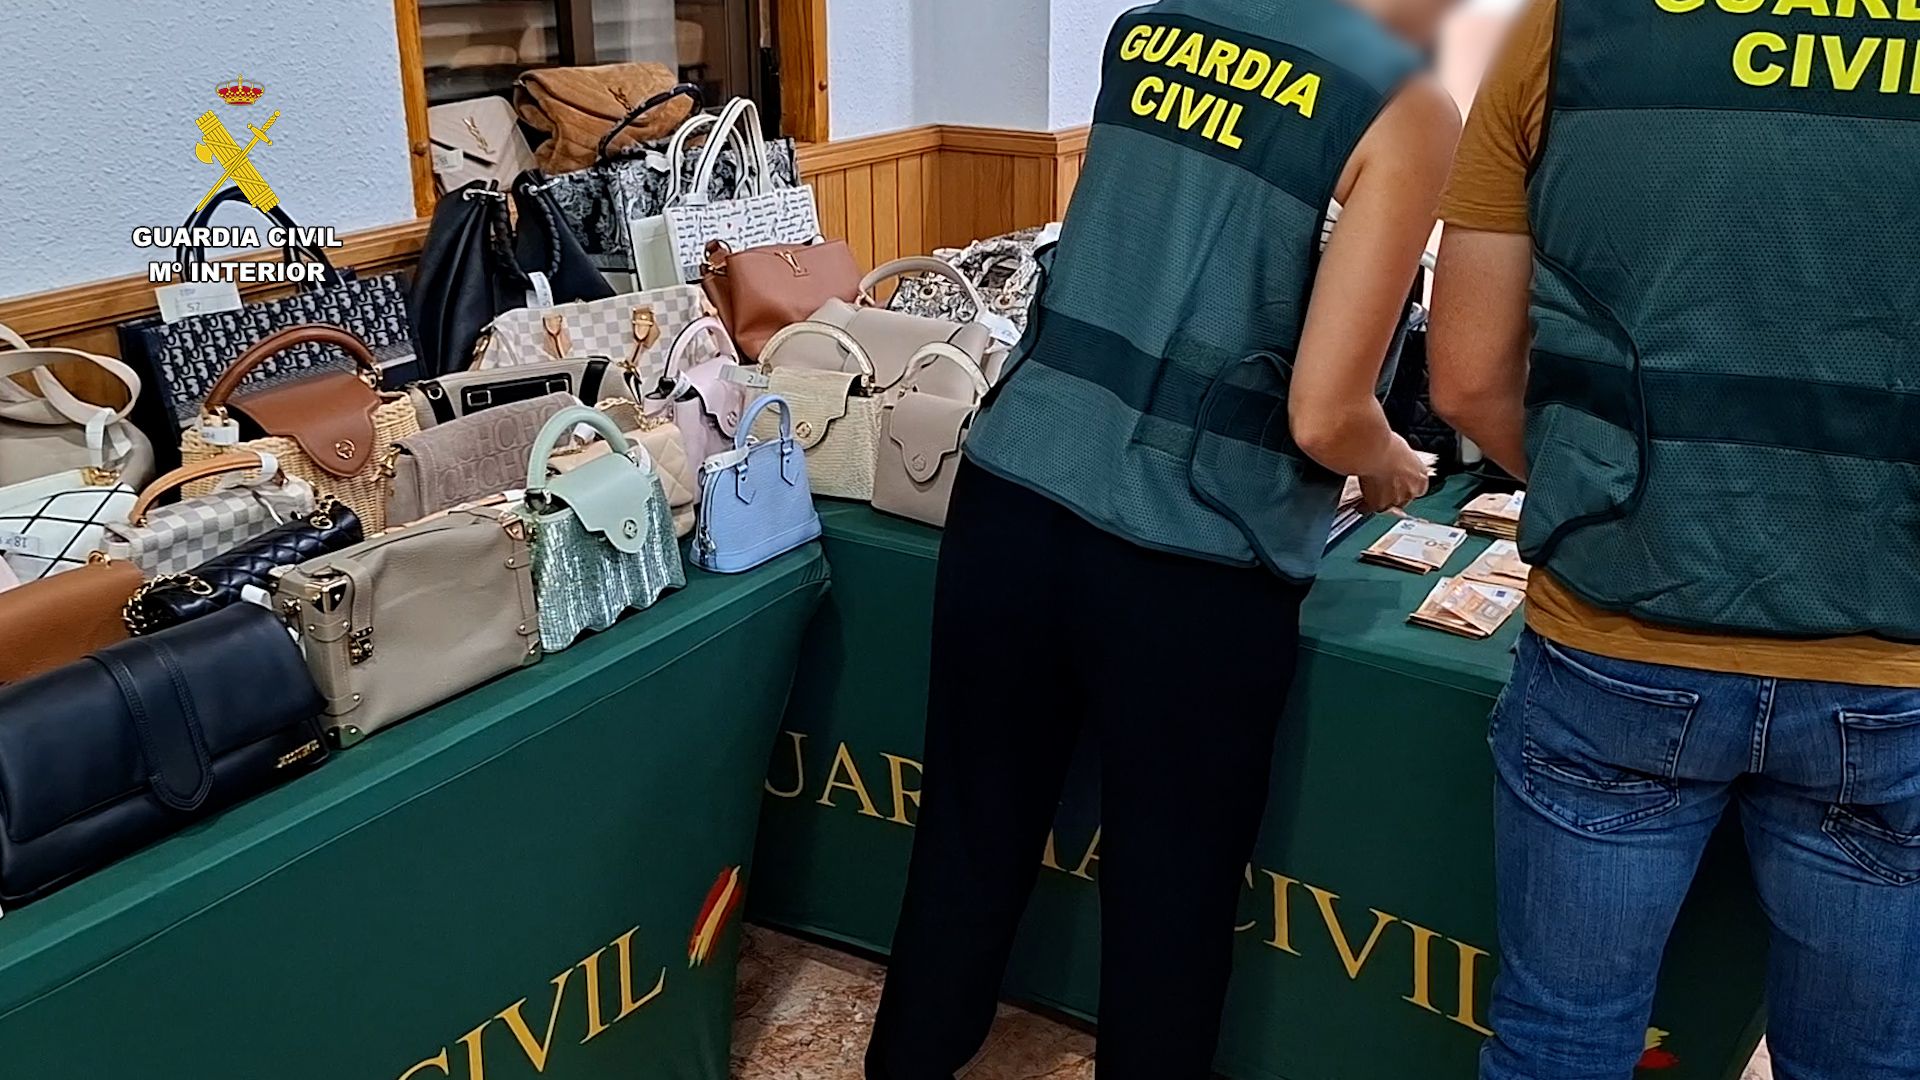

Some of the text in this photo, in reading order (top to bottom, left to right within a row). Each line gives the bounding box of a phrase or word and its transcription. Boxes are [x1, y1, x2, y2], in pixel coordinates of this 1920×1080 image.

[1120, 25, 1321, 118] GUARDIA
[1732, 31, 1920, 94] CIVI
[1131, 76, 1244, 149] CIVIL
